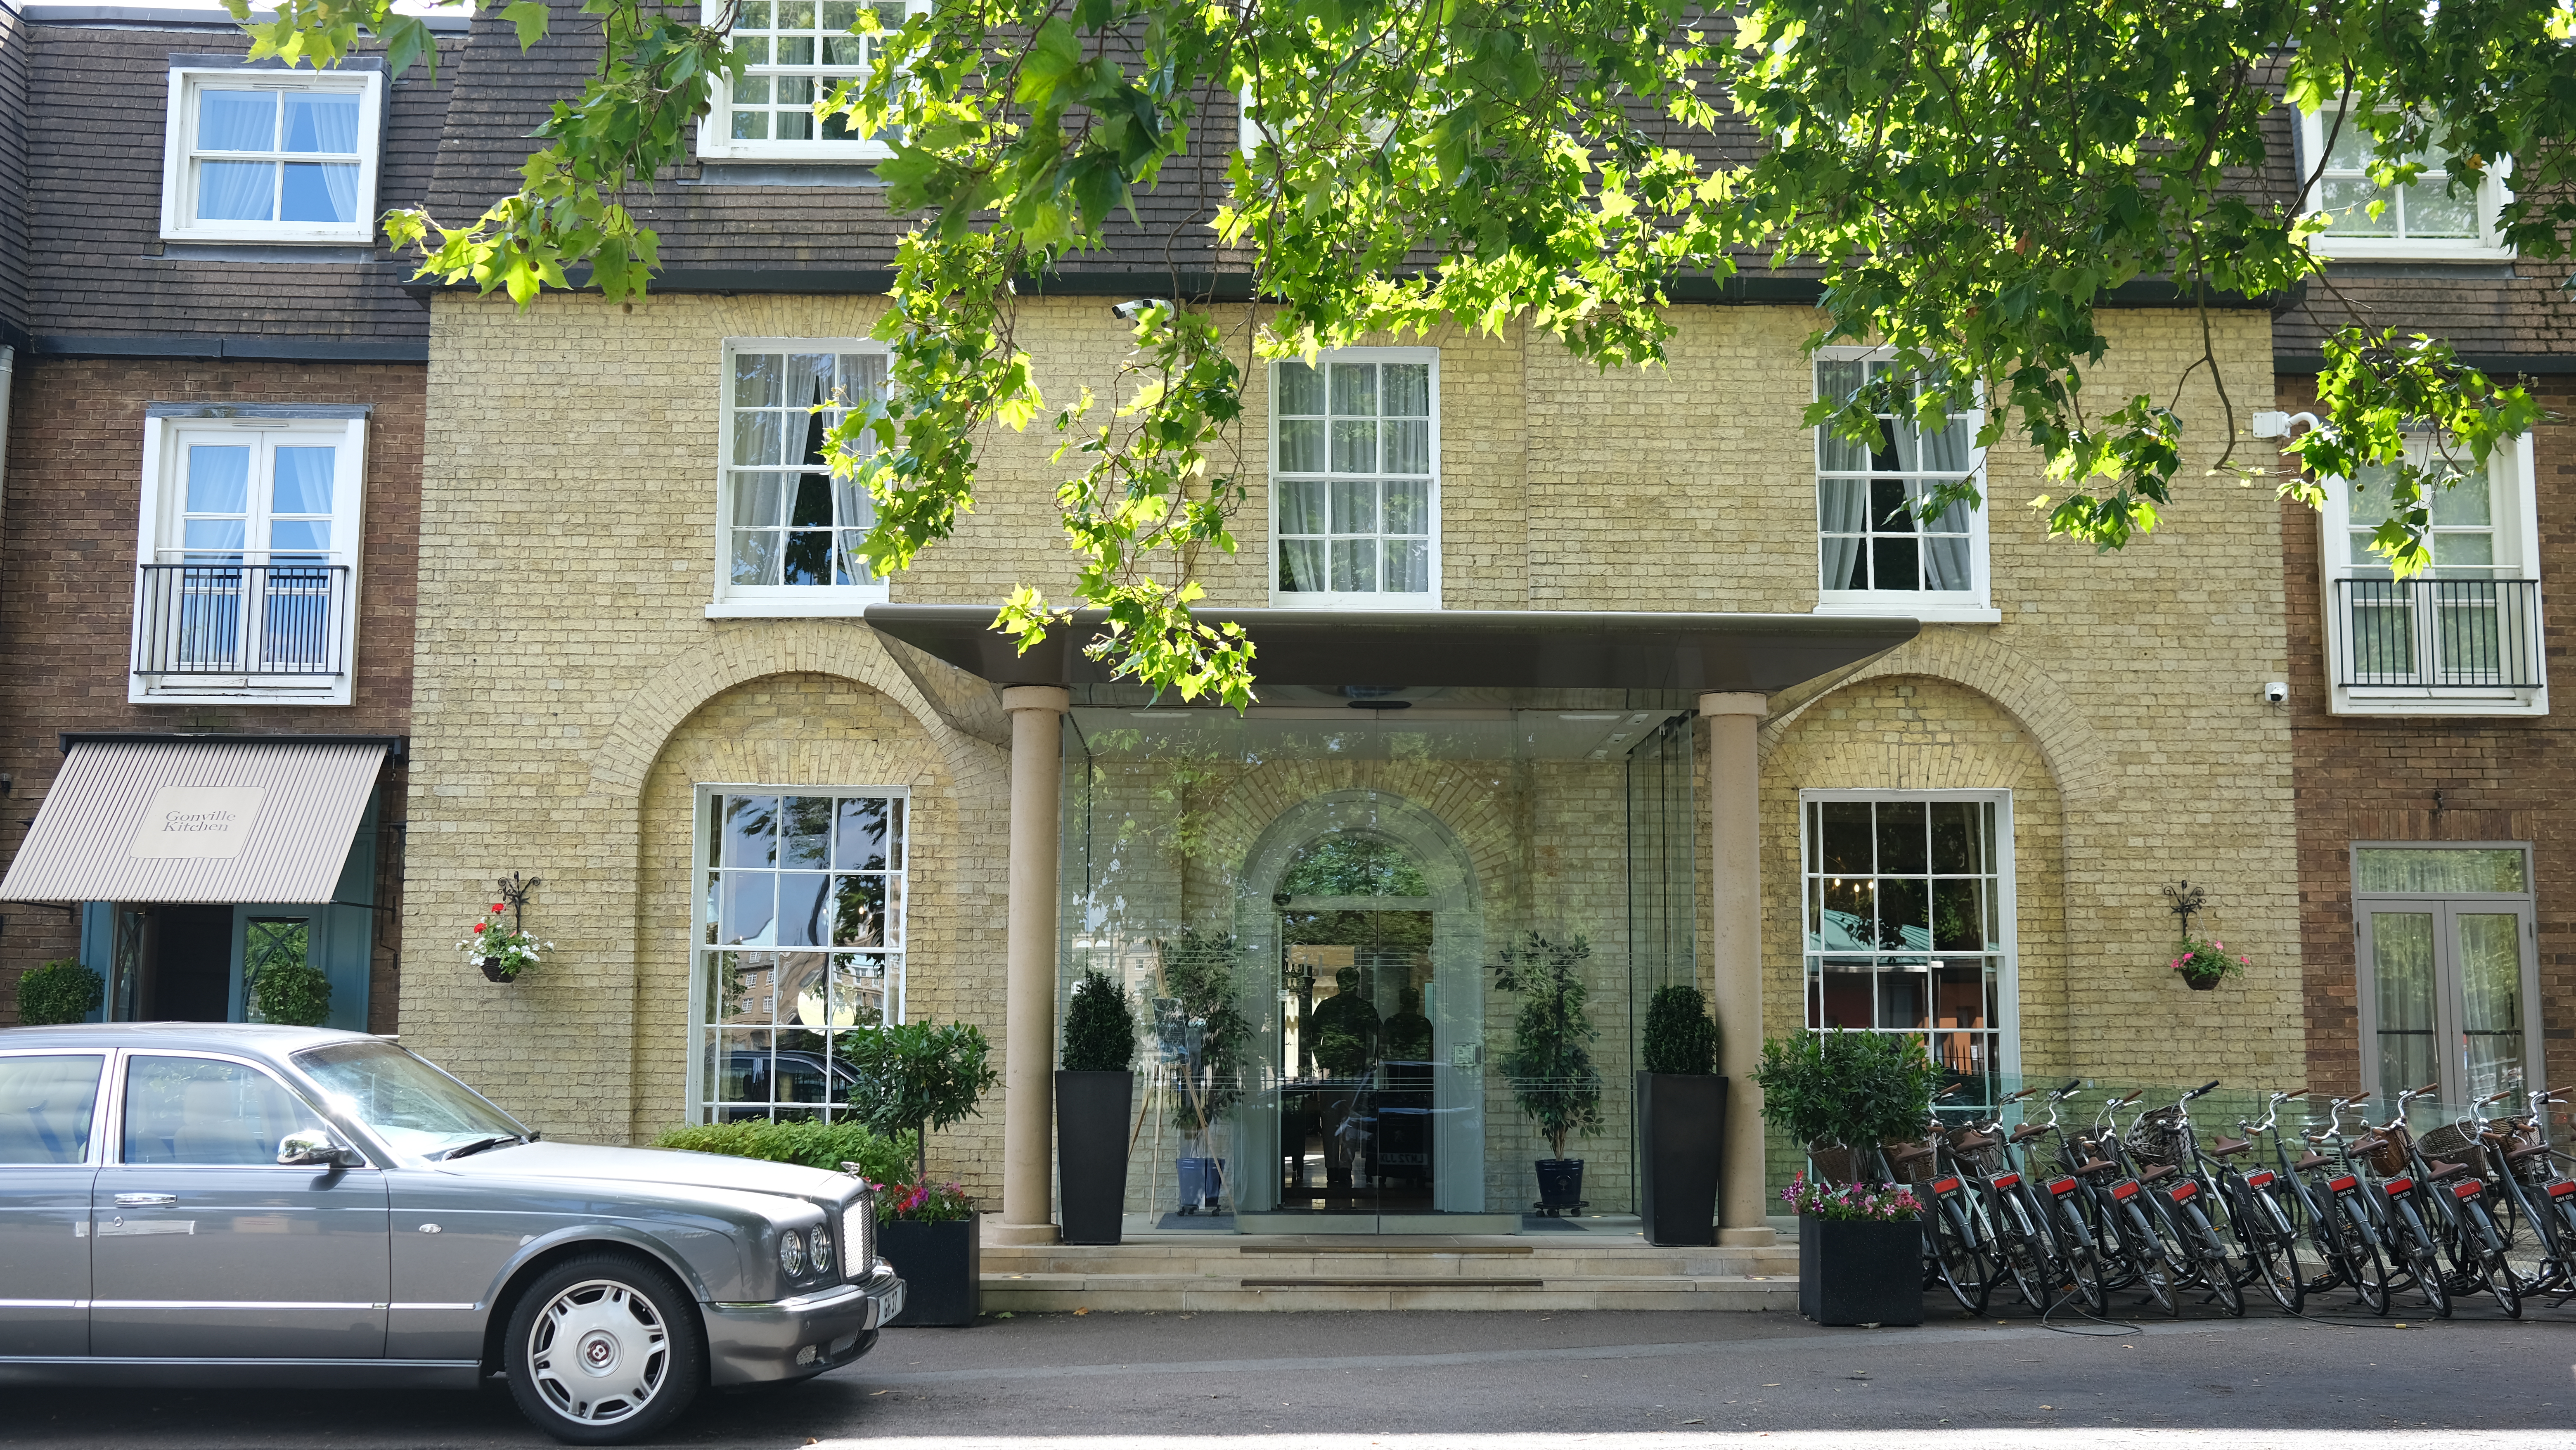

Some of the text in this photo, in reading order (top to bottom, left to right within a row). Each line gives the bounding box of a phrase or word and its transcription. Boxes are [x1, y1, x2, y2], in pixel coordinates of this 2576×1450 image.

[166, 810, 236, 821] Gonville
[161, 821, 228, 832] Kitchen
[884, 1291, 897, 1319] GH 37
